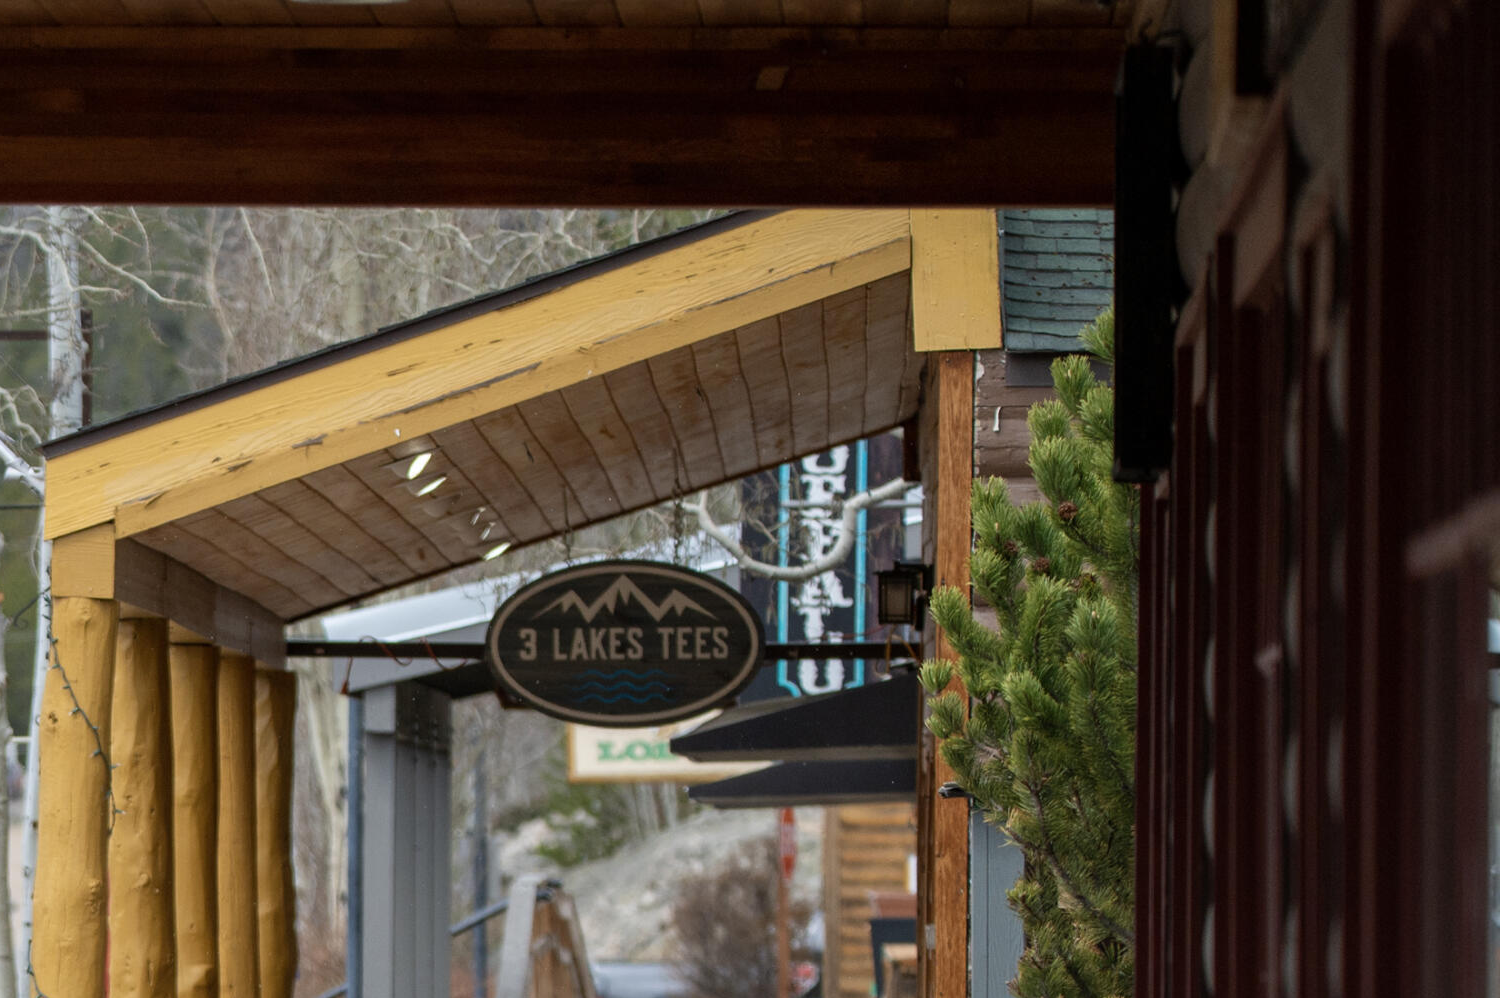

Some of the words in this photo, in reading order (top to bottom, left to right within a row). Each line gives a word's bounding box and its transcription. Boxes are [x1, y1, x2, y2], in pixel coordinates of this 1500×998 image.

[519, 628, 537, 661] 3
[553, 628, 643, 661] LAKES
[657, 626, 729, 660] TEES
